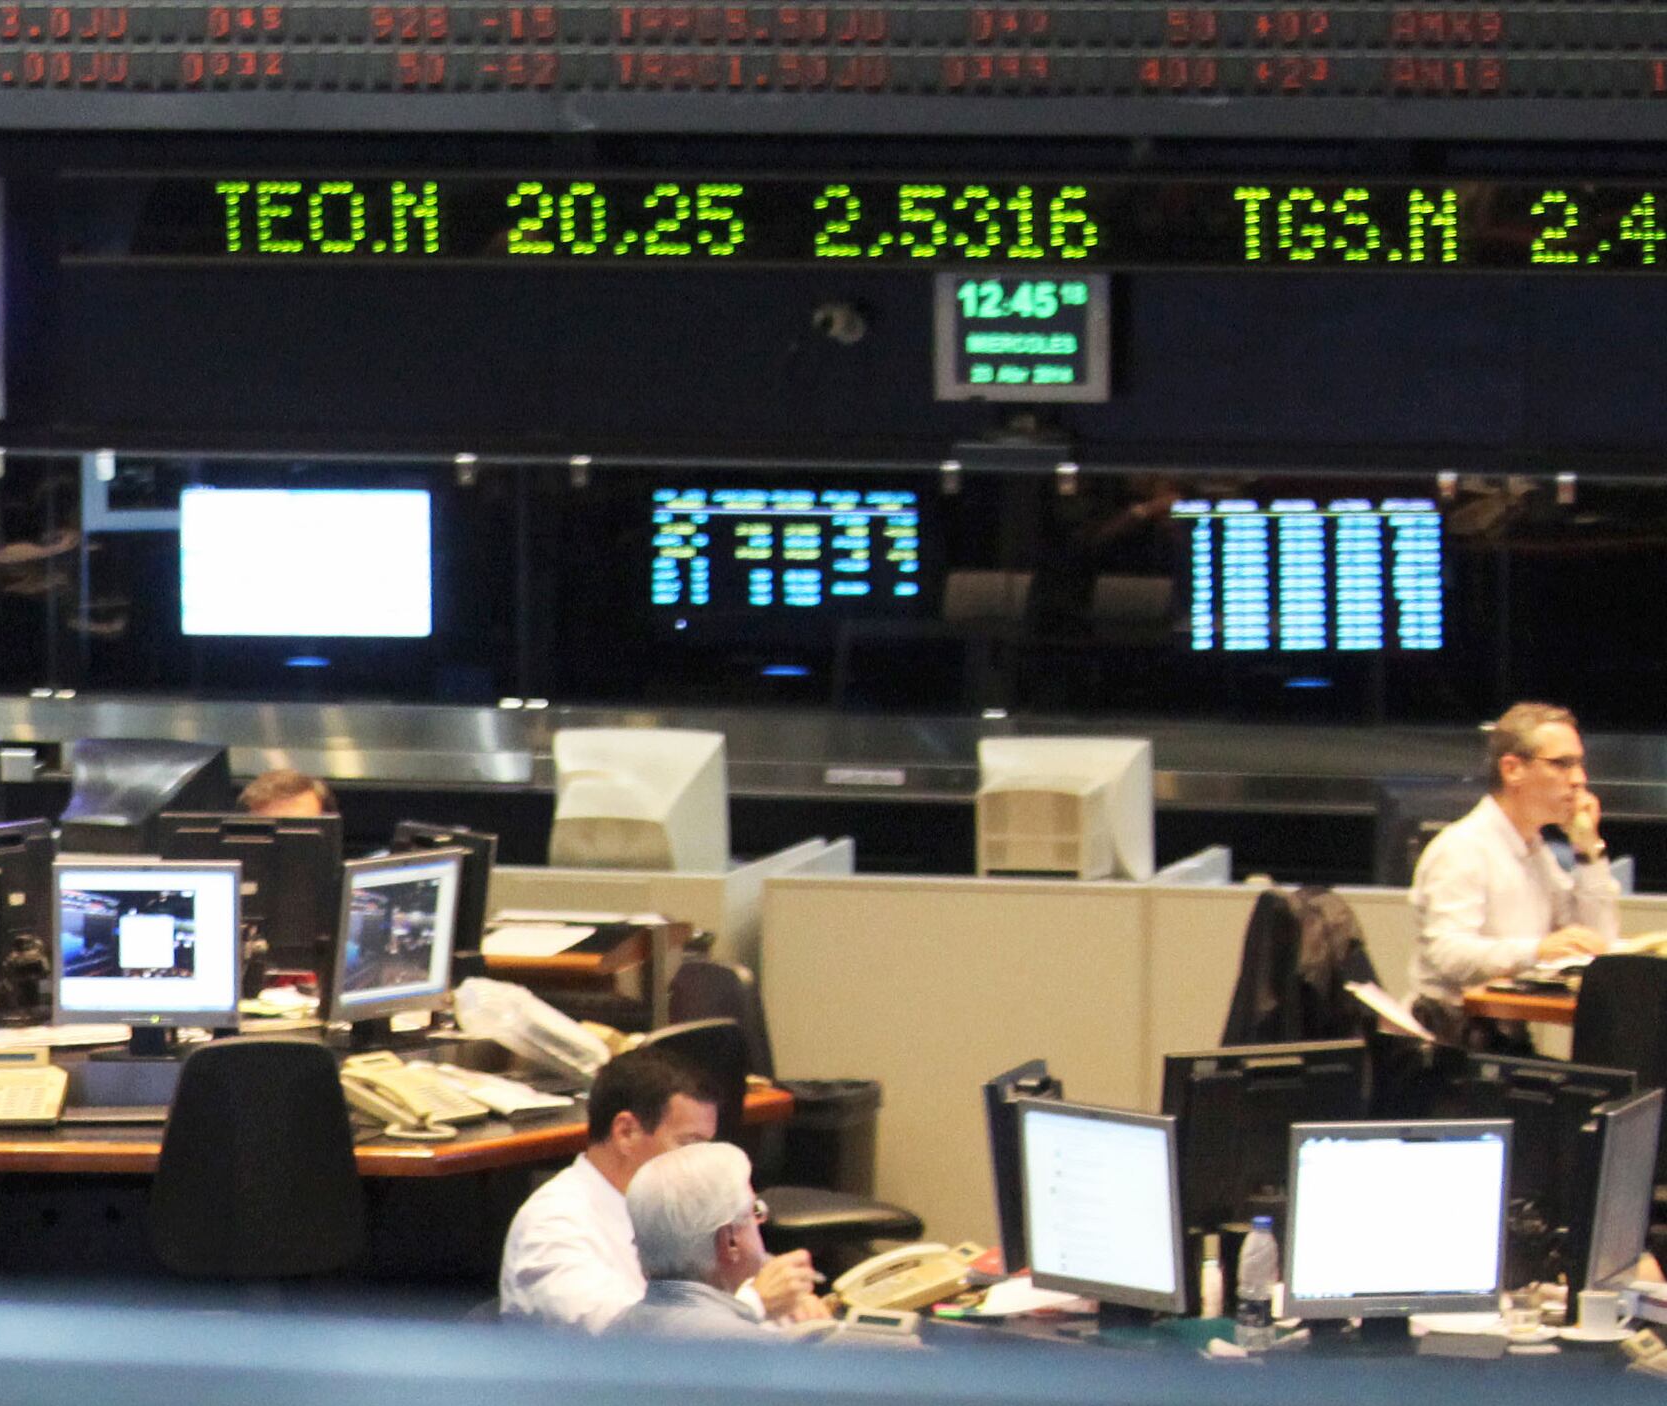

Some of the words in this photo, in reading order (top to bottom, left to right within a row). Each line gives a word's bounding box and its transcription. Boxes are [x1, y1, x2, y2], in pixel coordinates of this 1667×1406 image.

[217, 183, 440, 254] TEO.N
[508, 183, 745, 256] 20,25
[815, 186, 1099, 259] 2,5316
[1235, 188, 1458, 263] TGS.N
